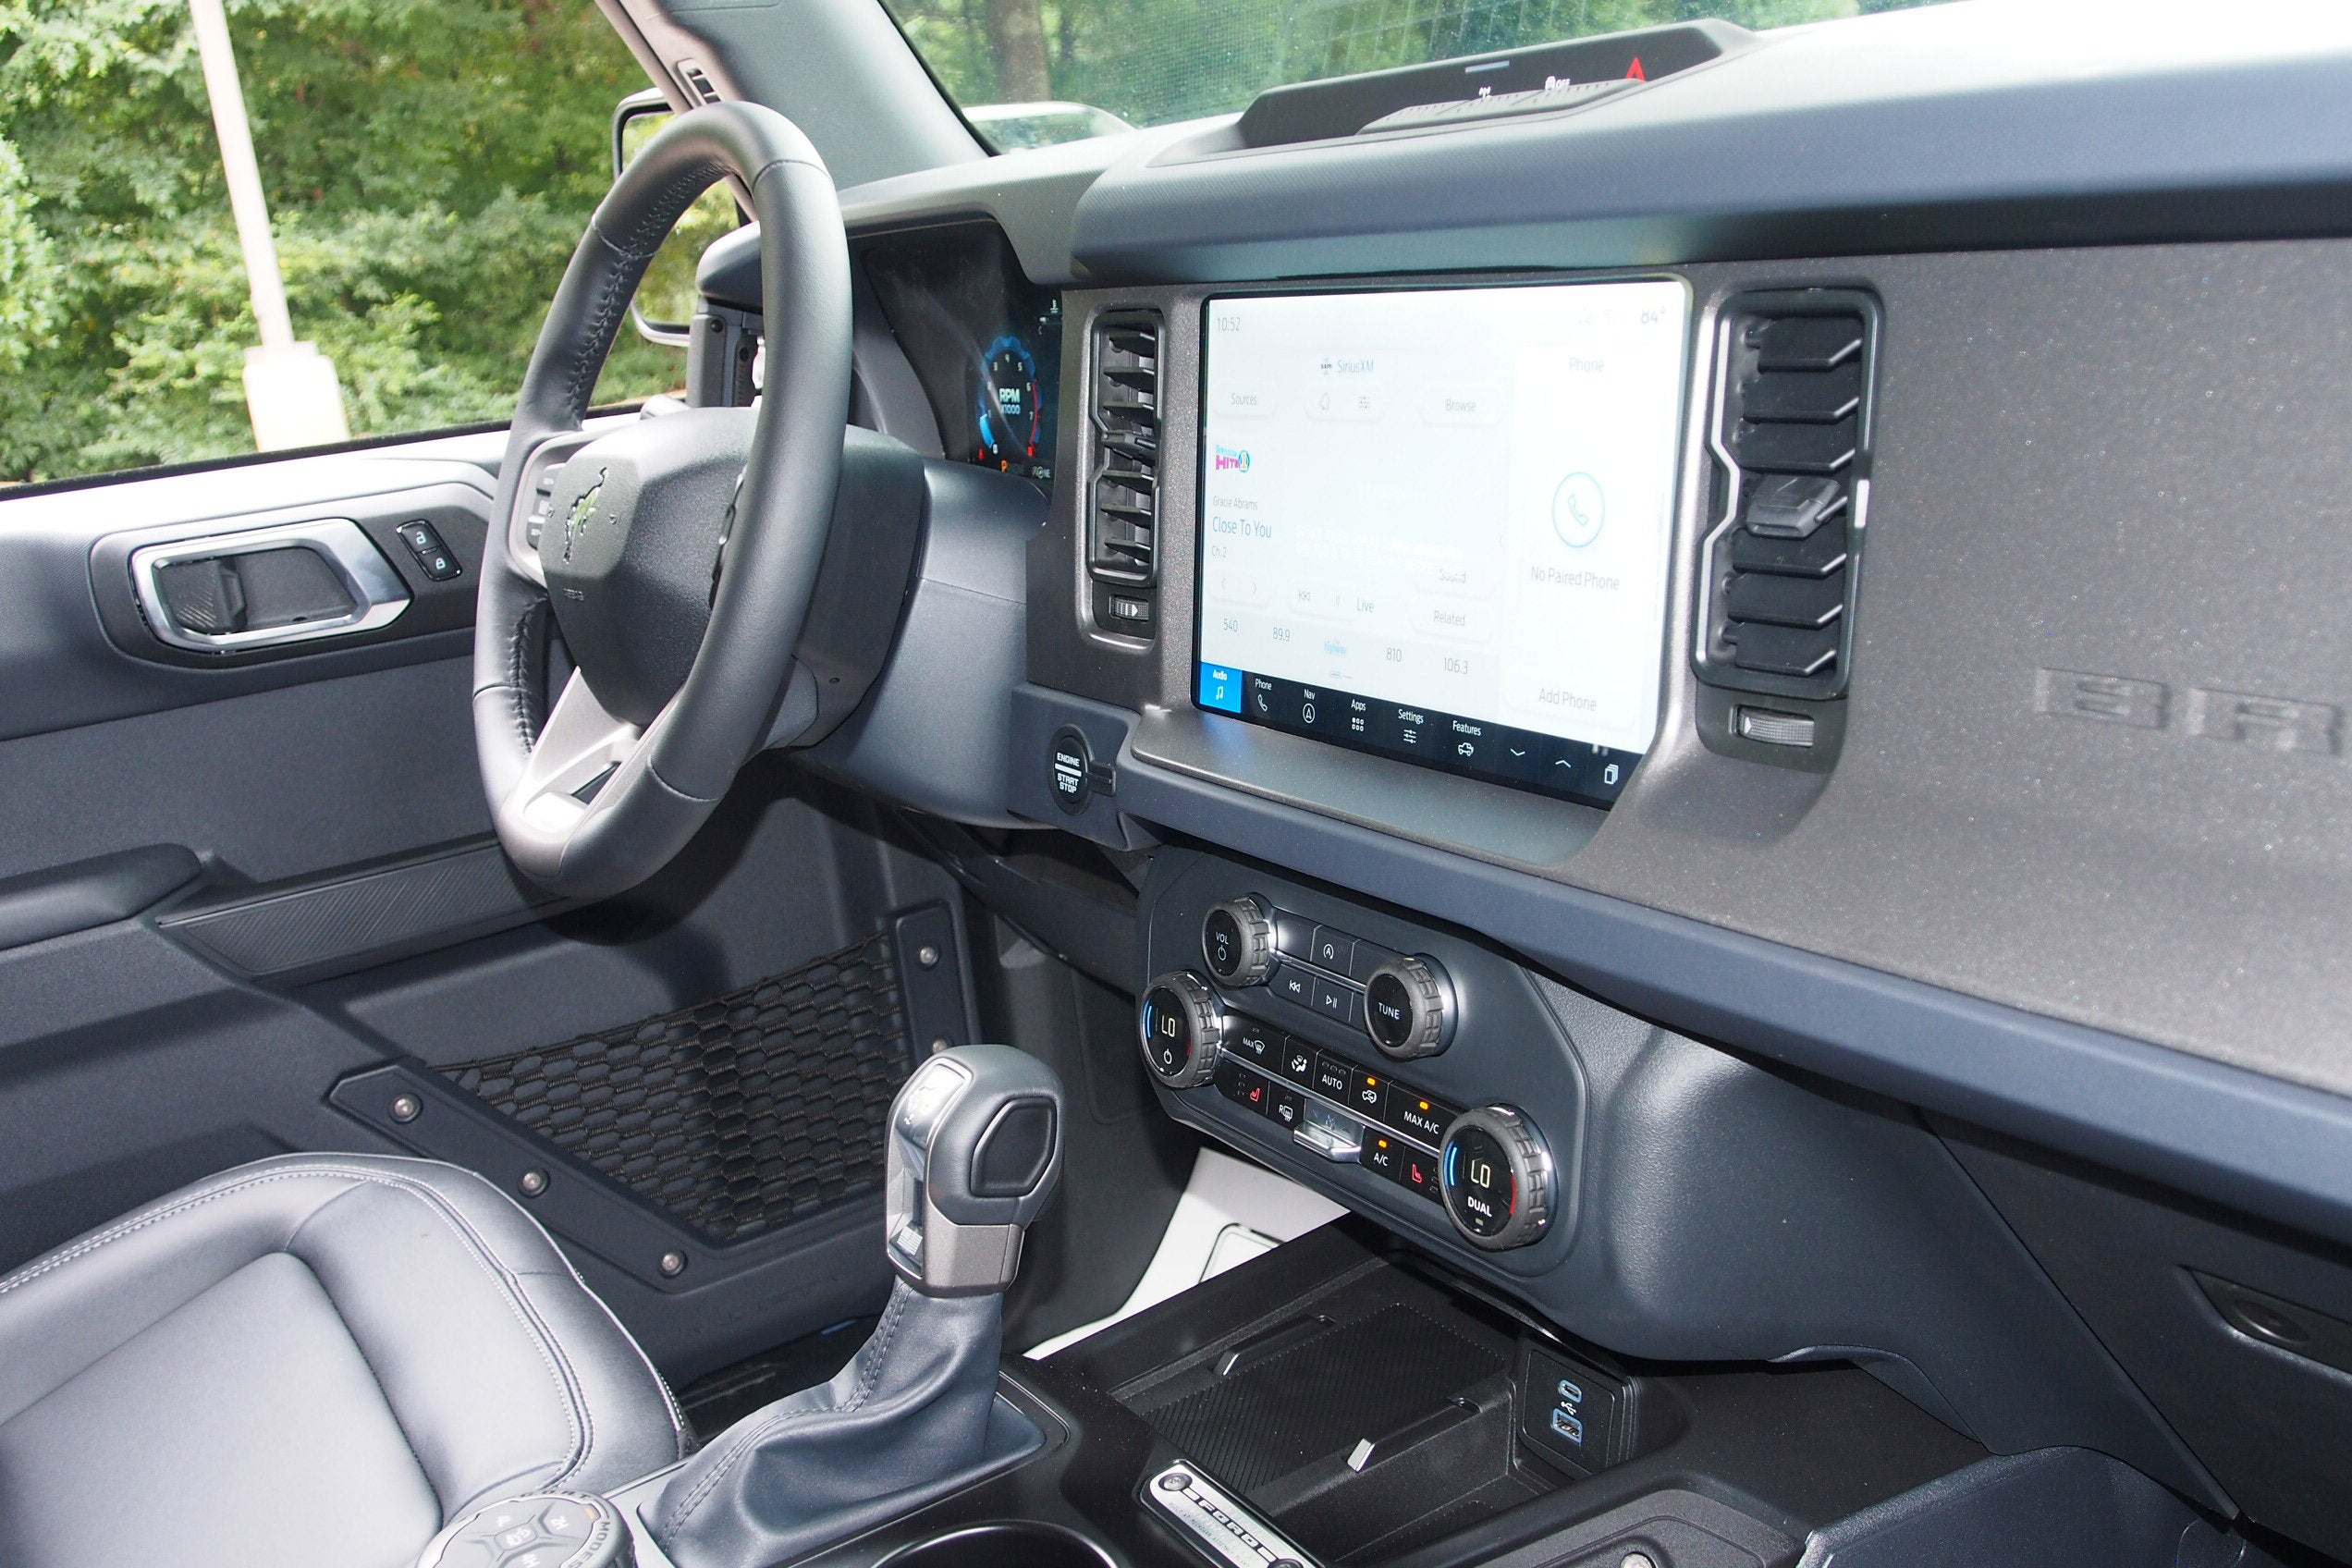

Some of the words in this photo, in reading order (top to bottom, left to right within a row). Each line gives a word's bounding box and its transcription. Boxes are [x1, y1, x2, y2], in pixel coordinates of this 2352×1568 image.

[1216, 316, 1241, 332] 10:52
[1337, 359, 1375, 374] SiriusXM
[1568, 356, 1605, 374] Phone
[999, 388, 1020, 403] RPM
[1231, 392, 1257, 407] Sources
[1445, 398, 1477, 413] Browse
[1212, 516, 1237, 534] Close
[1240, 519, 1252, 536] To
[1254, 521, 1272, 538] You
[1531, 566, 1546, 582] No
[1548, 567, 1581, 587] Paired
[1582, 571, 1621, 592] Phone
[1356, 597, 1375, 614] Live
[1222, 618, 1239, 634] 540
[1433, 609, 1466, 628] Related
[1272, 627, 1291, 643] 89.9
[1386, 647, 1403, 663] 810
[1213, 669, 1228, 680] Audio
[1443, 657, 1469, 676] 106.3
[1255, 678, 1272, 691] Phone
[1304, 689, 1316, 700] Nav
[1538, 687, 1560, 705] Add
[1561, 690, 1598, 712] Phone
[1351, 699, 1366, 712] Apps
[1398, 708, 1424, 724] Settings
[1452, 720, 1481, 736] Features
[1057, 752, 1080, 767] ENGINE
[1057, 772, 1079, 786] START
[1060, 781, 1077, 794] STOP
[1216, 932, 1229, 946] VOL
[1378, 1001, 1401, 1021] TUNE
[1243, 1037, 1255, 1049] MAX
[1322, 1073, 1343, 1091] AUTO
[1403, 1111, 1423, 1130] MAX
[1423, 1119, 1439, 1135] A/C
[1373, 1152, 1389, 1168] A/C
[1467, 1196, 1492, 1218] DUAL
[1198, 1500, 1258, 1548] FORD
